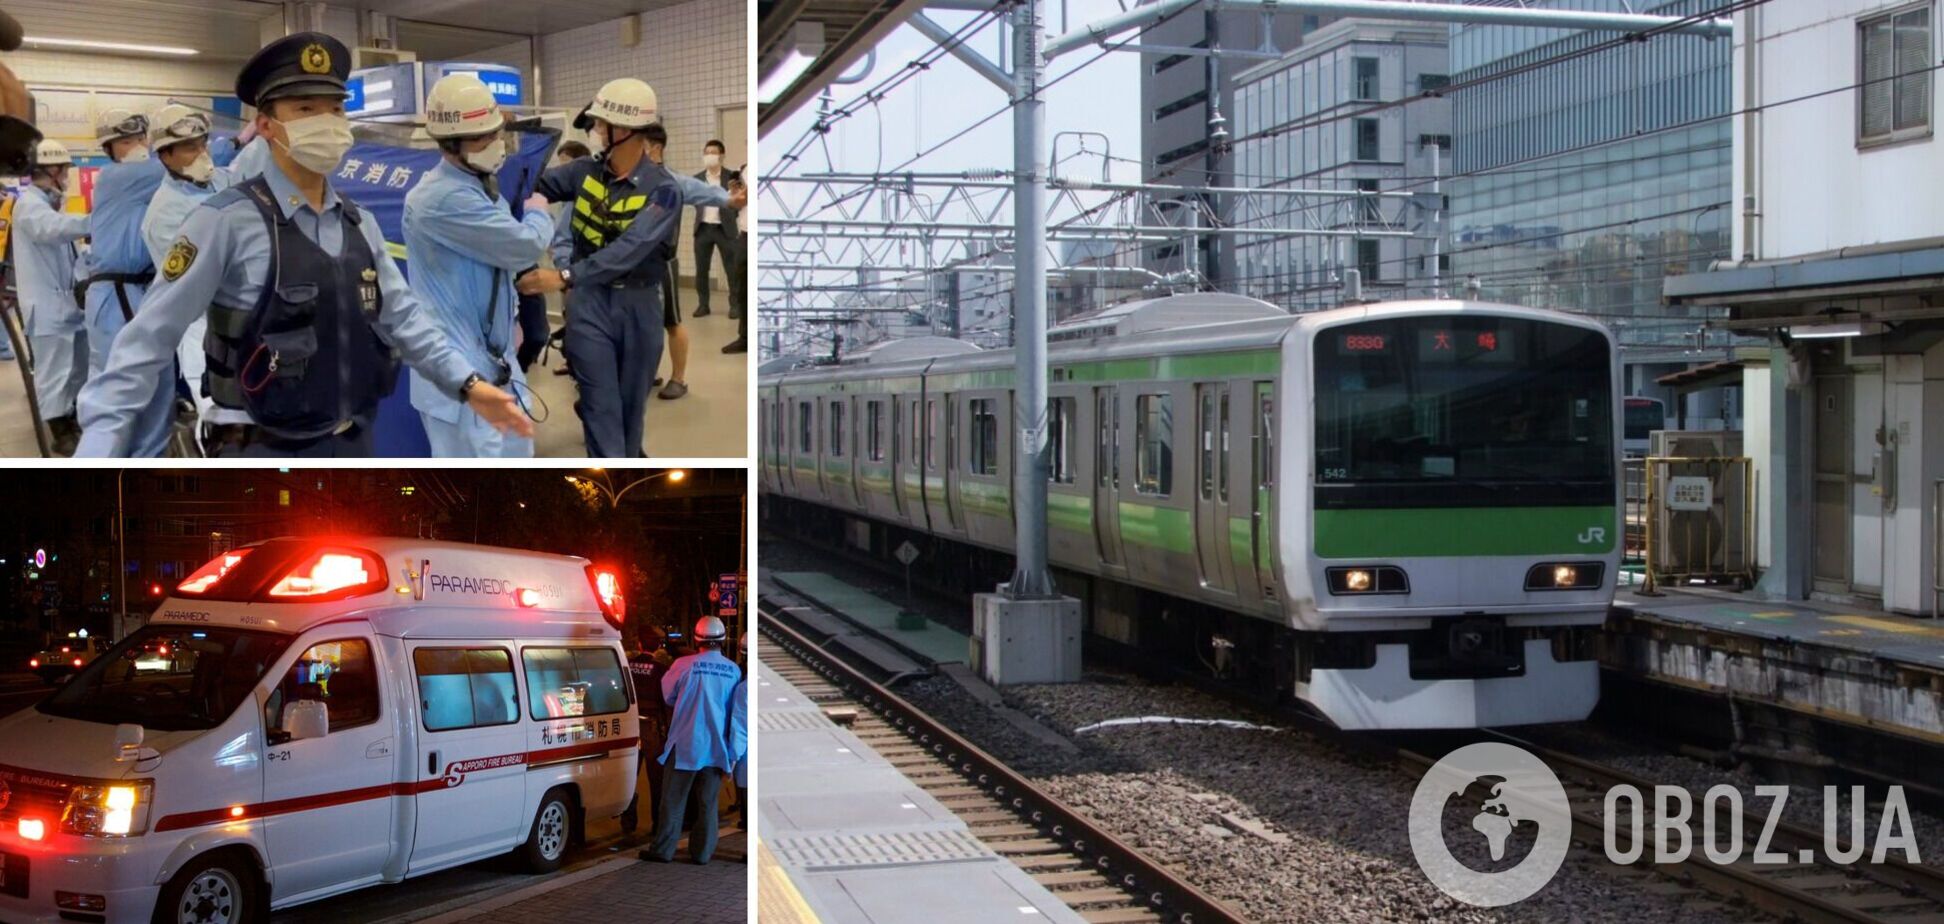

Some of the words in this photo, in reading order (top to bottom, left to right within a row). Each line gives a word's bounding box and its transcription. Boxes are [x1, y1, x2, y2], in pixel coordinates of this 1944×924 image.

[1324, 468, 1347, 478] 542
[1578, 527, 1605, 543] JR
[430, 574, 511, 596] PARAMEDIC
[163, 610, 211, 622] PARAMEDIC
[487, 757, 501, 768] FIRE
[500, 754, 524, 766] BUREAU
[20, 775, 60, 788] BUREAU
